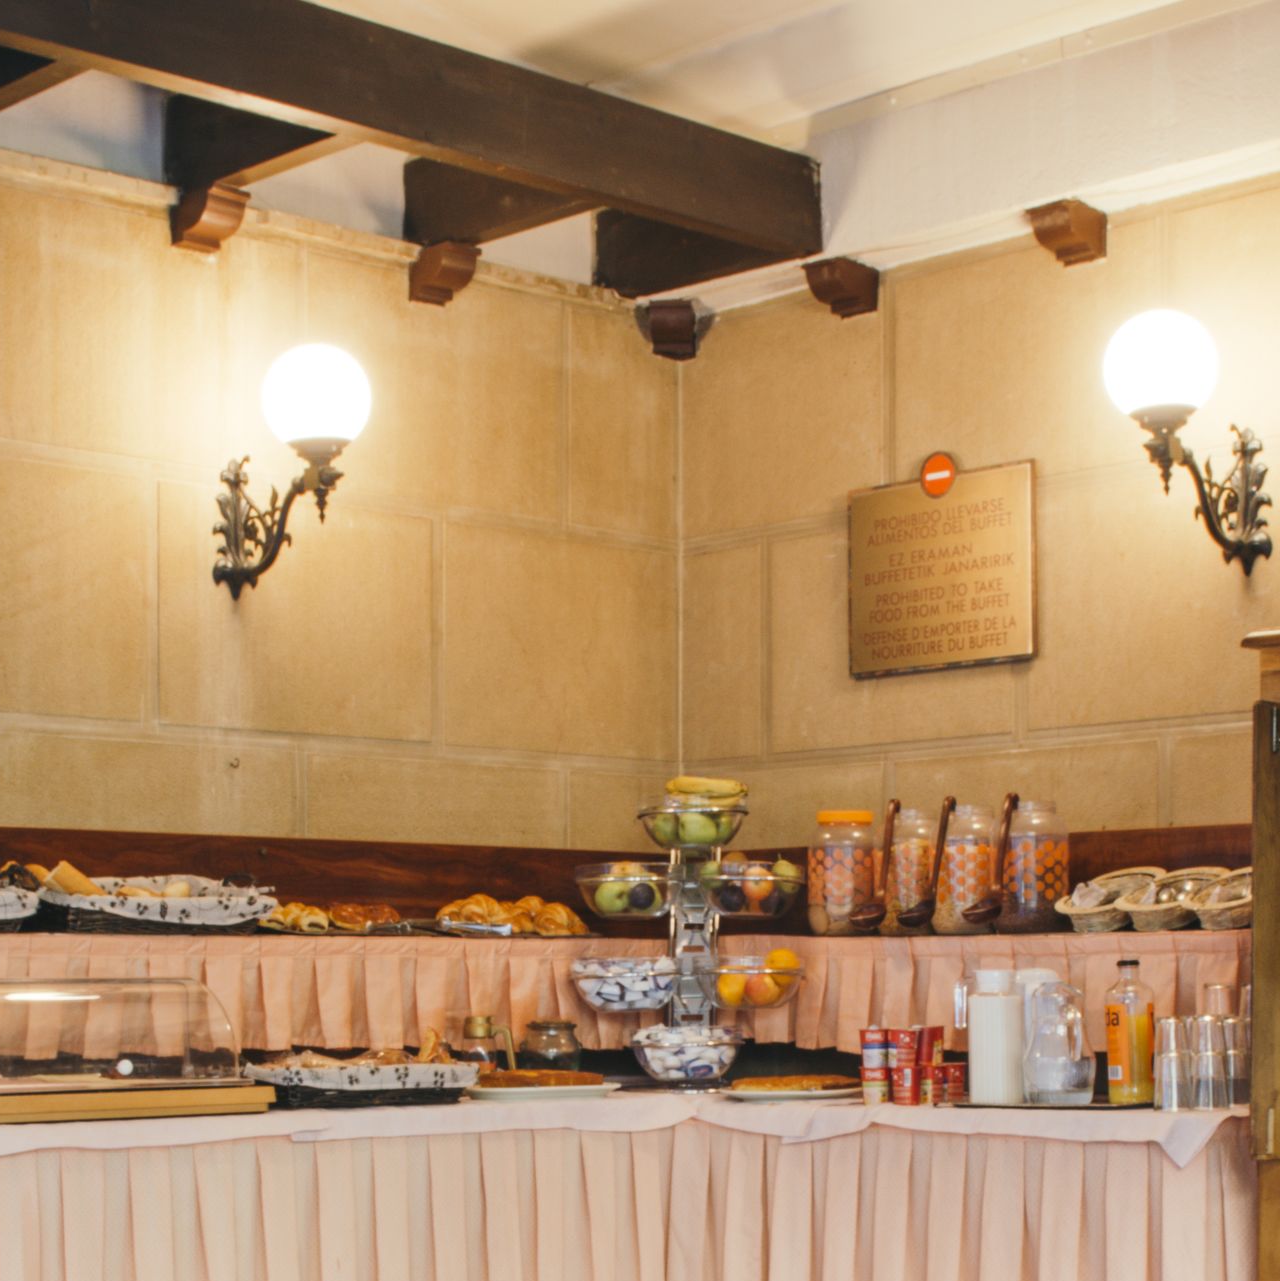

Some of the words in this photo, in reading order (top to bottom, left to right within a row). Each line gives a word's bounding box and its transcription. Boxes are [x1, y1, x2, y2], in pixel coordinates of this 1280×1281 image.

[867, 525, 938, 547] ALIMENTOS
[943, 521, 965, 536] DEL
[970, 512, 1012, 531] BUFFET
[874, 510, 942, 532] PROHIBIDO
[946, 497, 1005, 521] LLEVARSE
[864, 564, 935, 586] BUFFETETIK
[943, 552, 1015, 576] JANARIRIK
[889, 552, 905, 568] EZ
[911, 543, 973, 564] ERAMAN
[876, 586, 945, 607] PROHIBITED
[951, 582, 968, 598] TO
[974, 577, 1004, 594] TAKE
[869, 607, 903, 624] FOOD
[907, 604, 940, 619] FROM
[946, 600, 966, 614] THE
[971, 593, 1010, 611] BUFFET
[912, 619, 980, 641] D'EMPORTER
[984, 616, 999, 632] DE
[1002, 615, 1017, 630] LA
[871, 639, 943, 660] NOURRITURE
[949, 637, 965, 652] DU
[970, 631, 1008, 649] BUFFET
